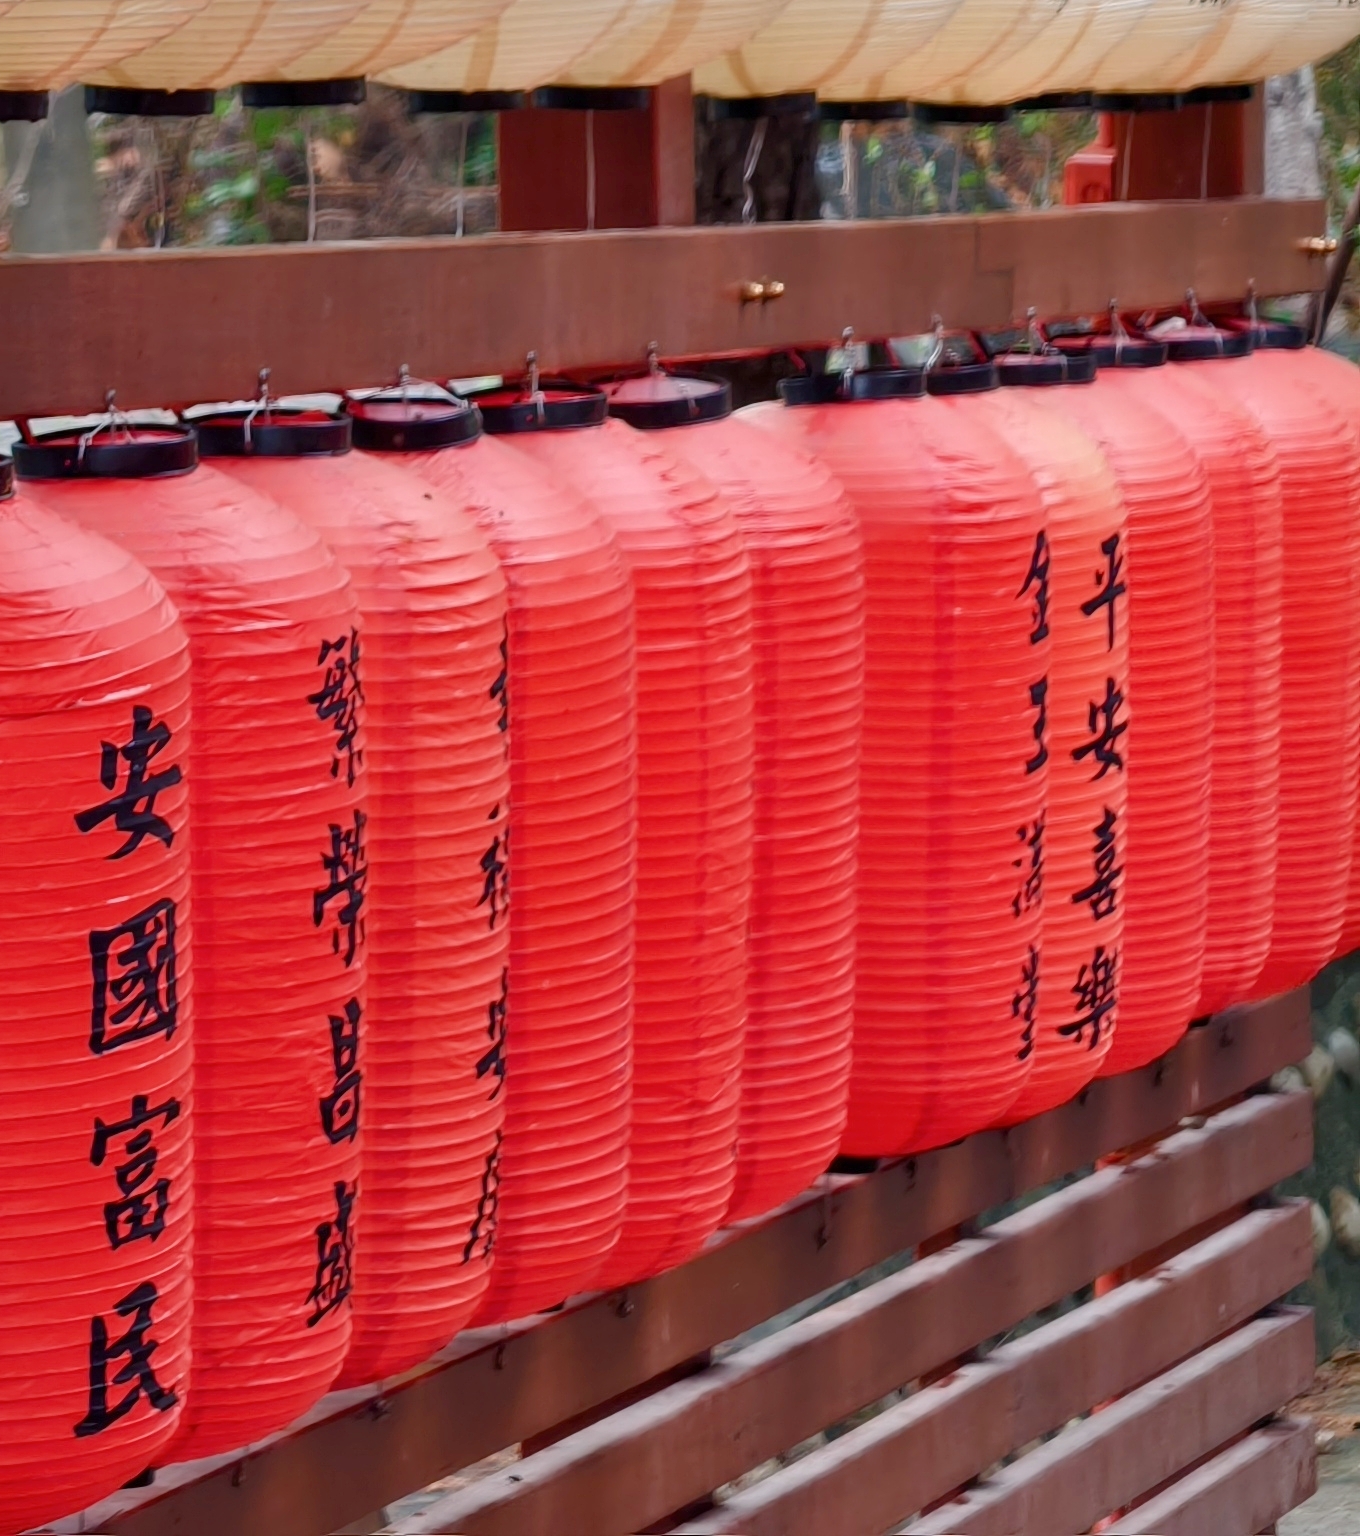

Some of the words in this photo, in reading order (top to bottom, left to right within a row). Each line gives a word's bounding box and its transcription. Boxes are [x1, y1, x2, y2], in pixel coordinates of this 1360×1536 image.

[73, 704, 183, 1440] 安國富民
[1056, 531, 1129, 1050] 平安喜樂
